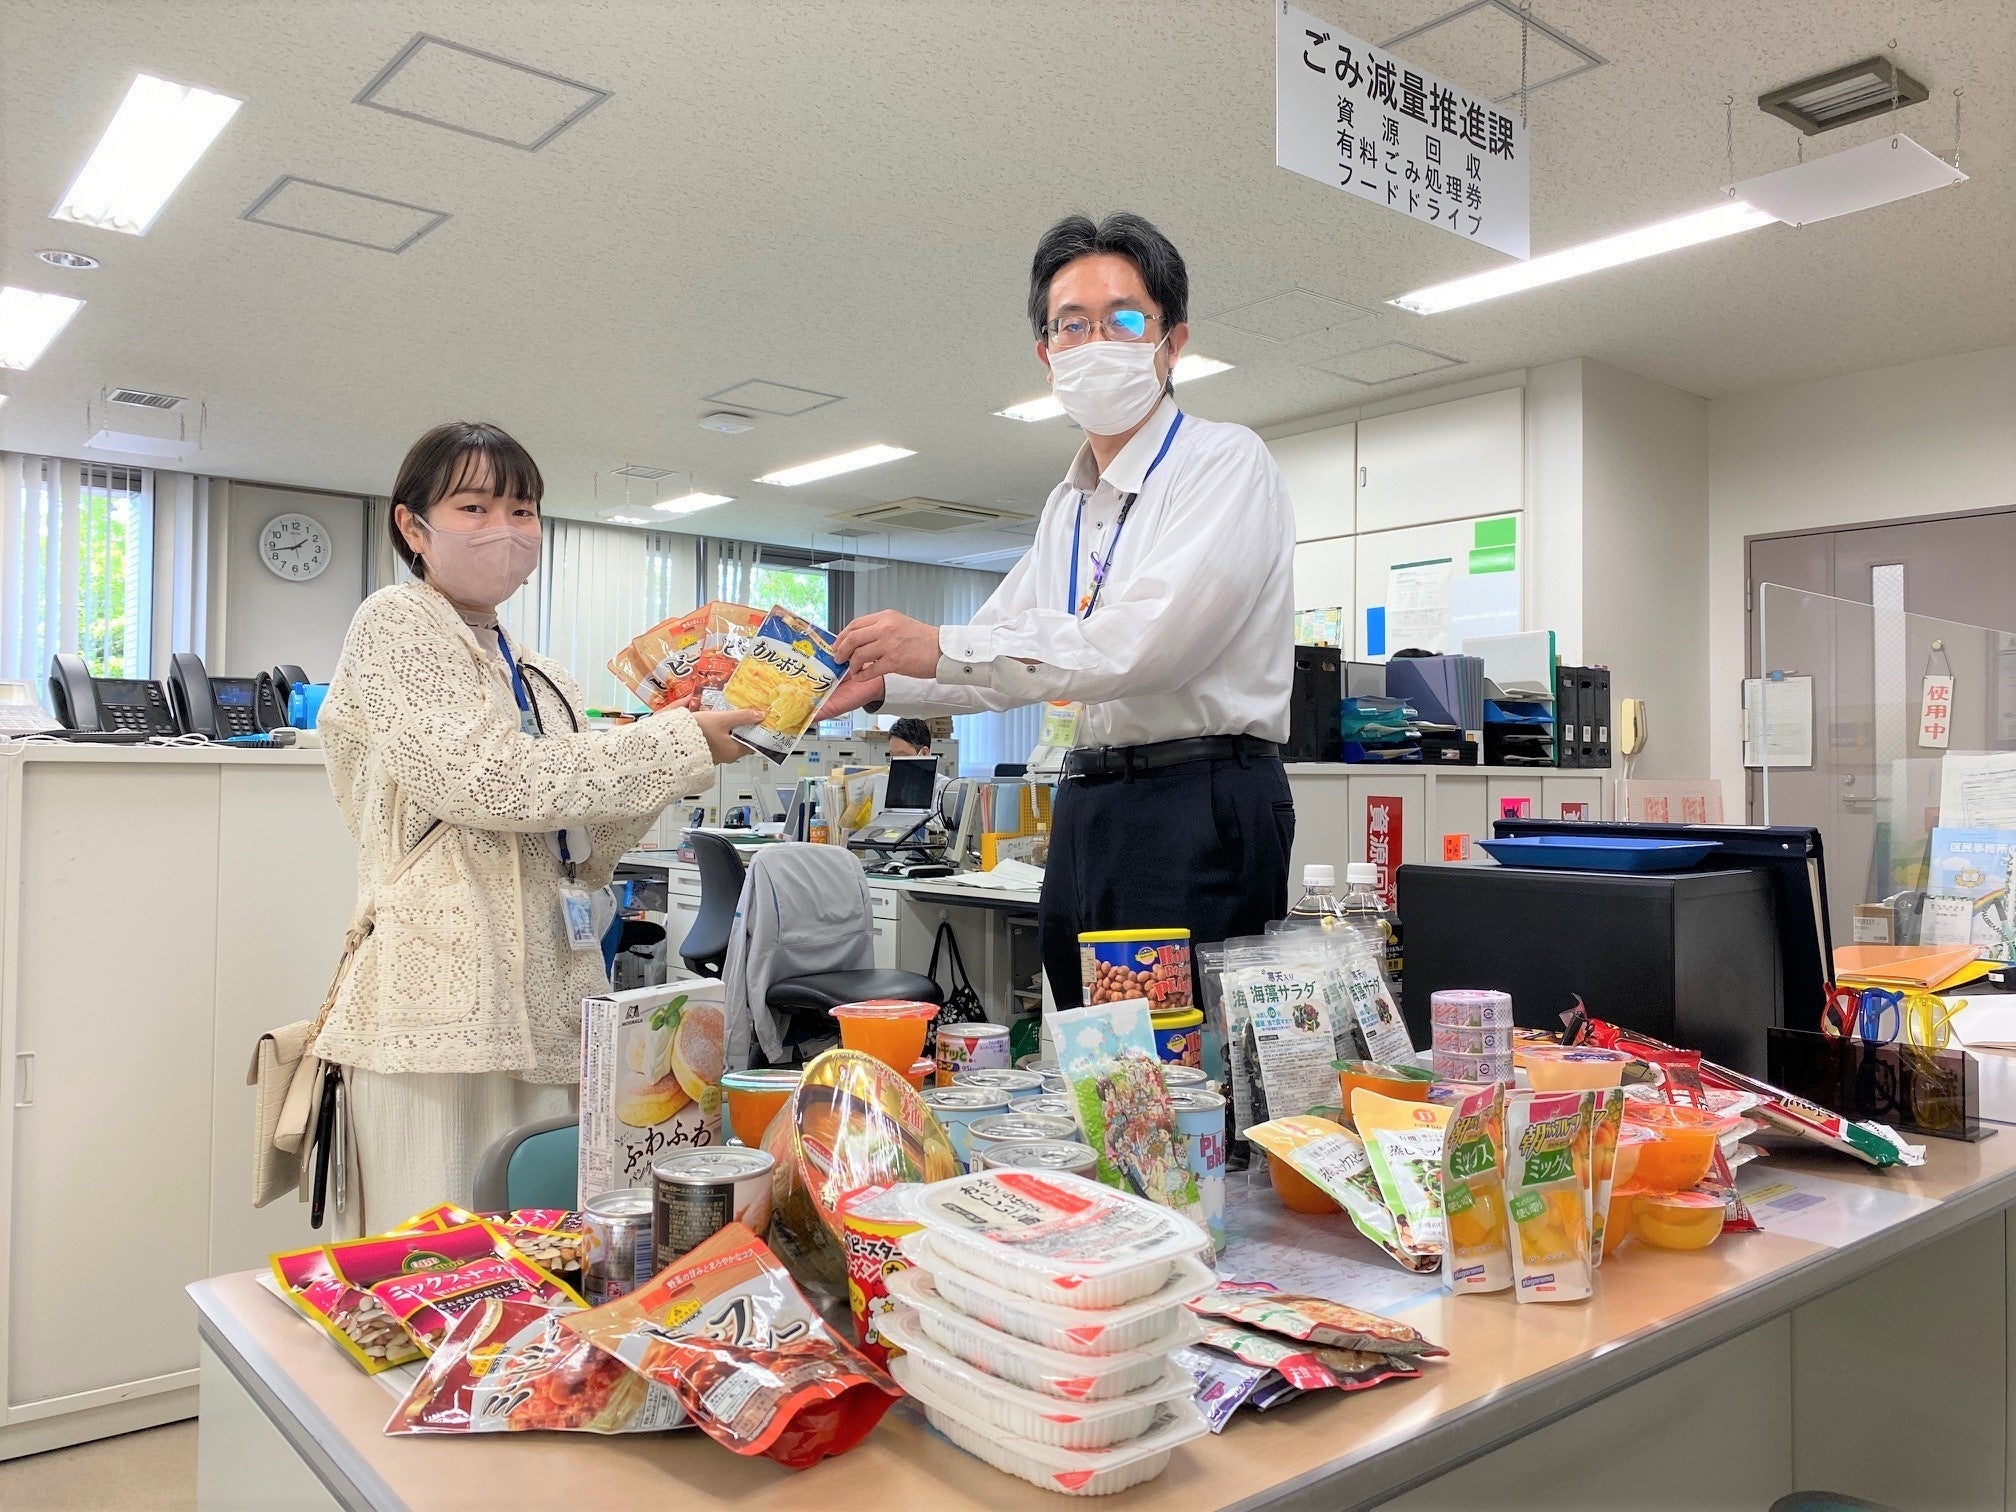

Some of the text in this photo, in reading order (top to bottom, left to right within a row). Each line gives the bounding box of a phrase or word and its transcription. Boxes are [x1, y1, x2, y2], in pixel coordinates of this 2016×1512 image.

[1303, 29, 1515, 162] ごみ減量推進課
[1337, 129, 1483, 211] 有料ごみ処理券
[281, 524, 288, 532] 11
[291, 522, 300, 531] 12
[305, 526, 309, 534] 1
[272, 531, 281, 539] 10
[312, 534, 319, 543] 2
[314, 545, 321, 553] 3
[272, 552, 279, 560] 8
[280, 561, 287, 569] 7
[291, 565, 299, 573] 6
[303, 563, 310, 571] 5
[753, 640, 833, 691] カルボナーラ
[1924, 685, 1950, 740] 使用中
[1266, 971, 1295, 983] 寒天入り
[1249, 980, 1316, 1005] 海藻サラダ
[624, 1118, 712, 1174] ふわふわ
[1454, 1143, 1494, 1179] ミックス
[1529, 1154, 1572, 1179] ミックス
[666, 1248, 754, 1290] 野菜の甘みとまろやかなコク
[1454, 1265, 1485, 1281] Hagoromo
[1522, 1274, 1555, 1288] Hagoromo
